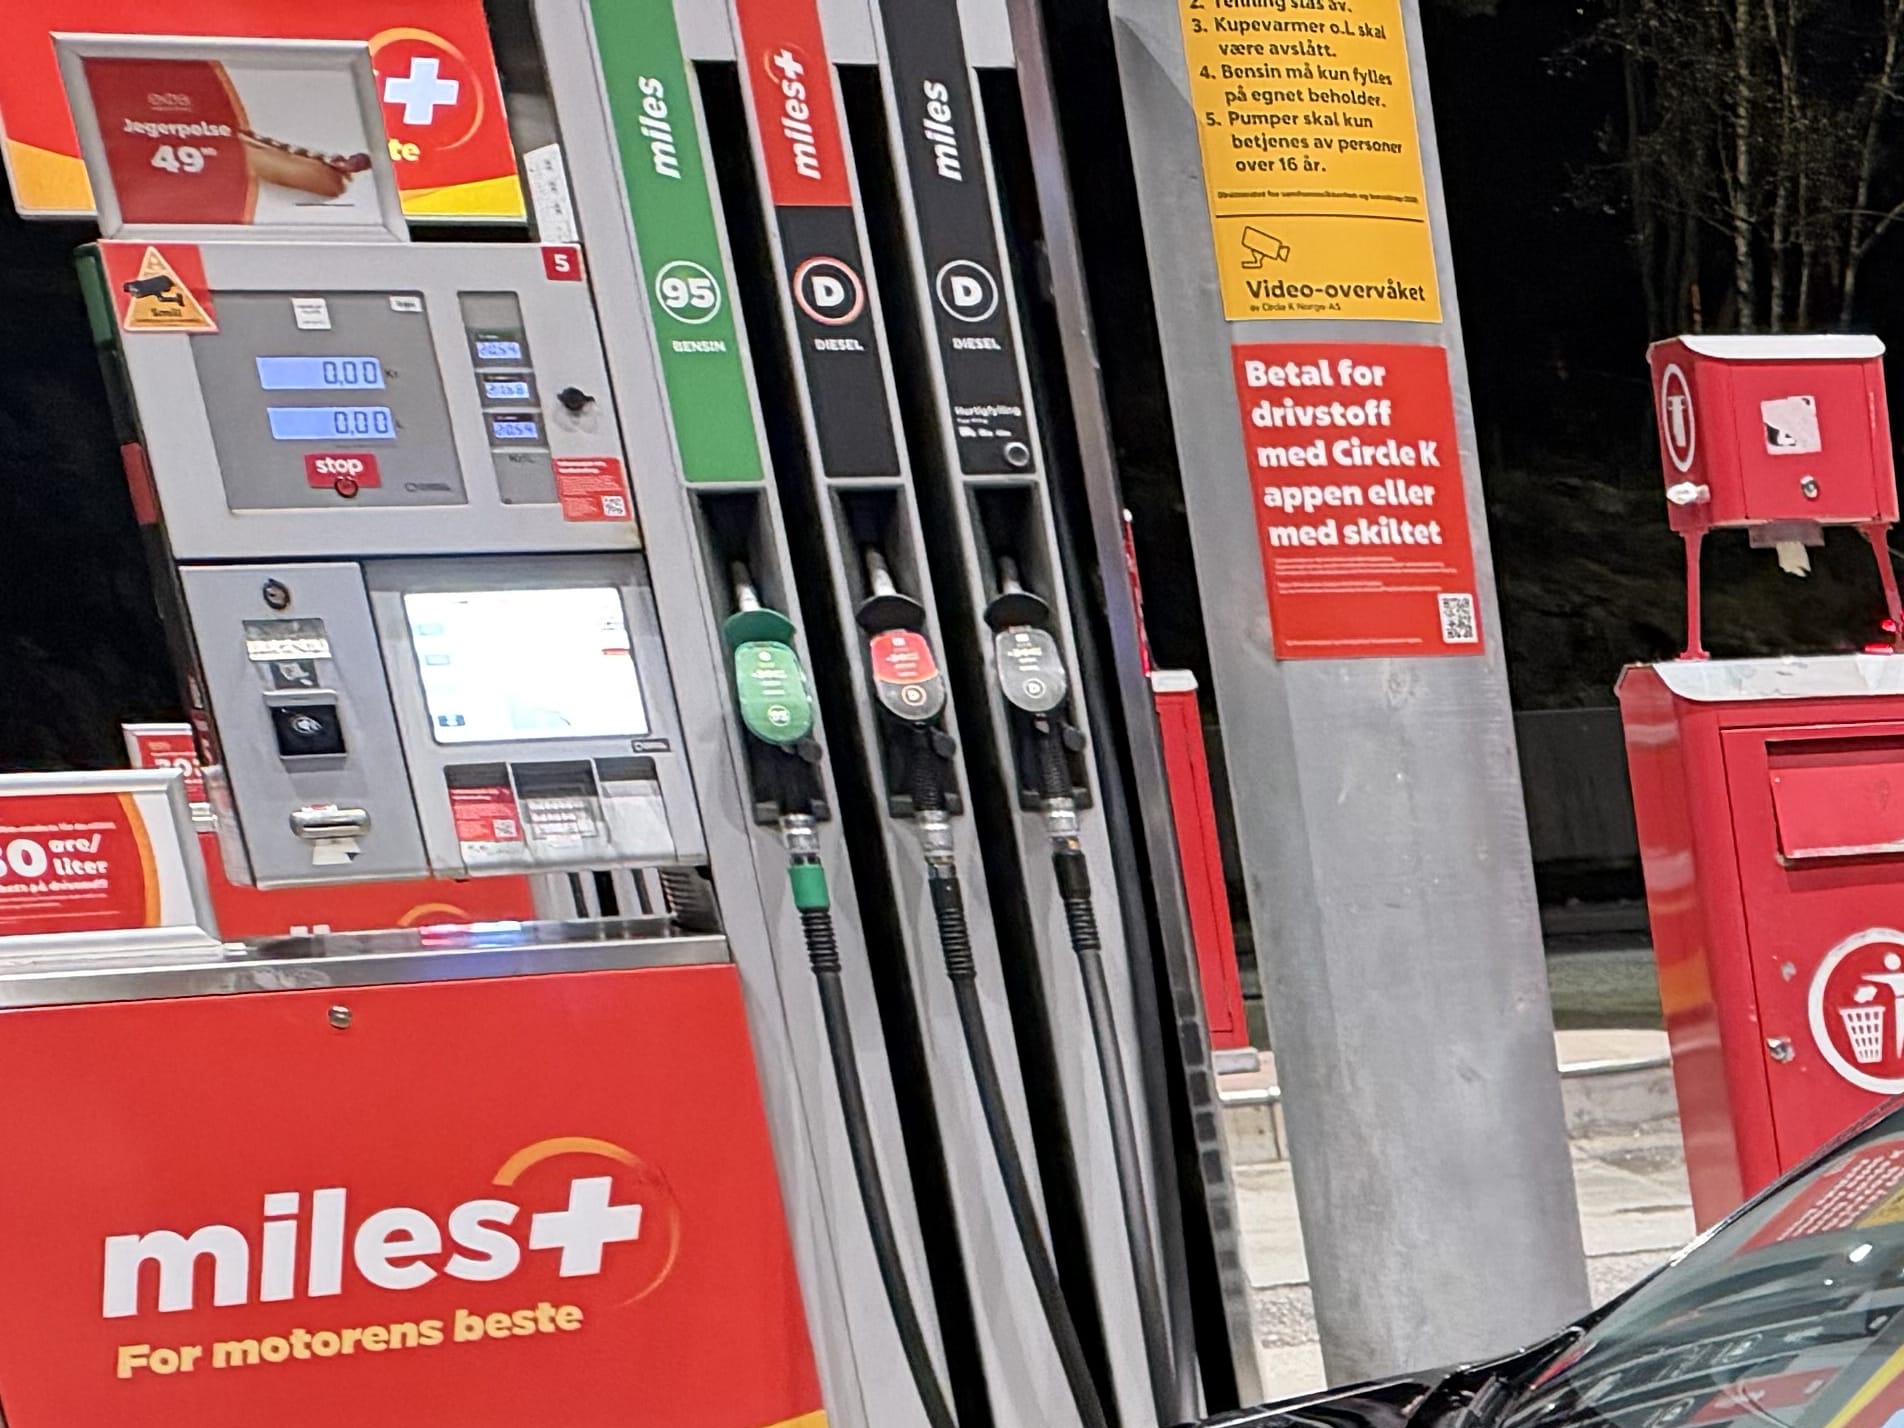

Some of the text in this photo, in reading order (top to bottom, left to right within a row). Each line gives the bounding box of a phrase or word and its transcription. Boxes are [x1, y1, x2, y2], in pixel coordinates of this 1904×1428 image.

[1192, 18, 1209, 33] 3.
[1215, 16, 1326, 36] Kupevarmer
[1358, 22, 1387, 40] skal
[1219, 39, 1337, 58] være avslått.
[1200, 62, 1393, 86] 4. Bensin må kun fylles
[1225, 85, 1387, 108] på egnet beholder.
[637, 75, 683, 181] miles
[921, 78, 964, 183] miles
[1205, 110, 1373, 130] 5. Pumper skal kun
[1231, 134, 1402, 155] betjenes av personer
[1235, 154, 1327, 172] over 16 år.
[554, 254, 571, 272] 5
[660, 274, 717, 308] 95
[812, 277, 846, 305] D
[951, 277, 983, 305] D
[1246, 278, 1426, 302] Video-overvåket
[672, 339, 726, 354] BENSIN
[814, 338, 865, 353] DIESEL
[952, 337, 1001, 350] DIESEL
[323, 361, 378, 386] 0,00
[1245, 358, 1386, 388] Betal for
[334, 410, 389, 436] 0,00
[1251, 397, 1392, 428] drivstoff
[1257, 436, 1440, 468] med Circle K
[314, 457, 364, 478] stop
[1264, 479, 1435, 513] appen eller
[1268, 516, 1443, 547] med skiltet
[116, 1301, 584, 1380] For motorens beste
